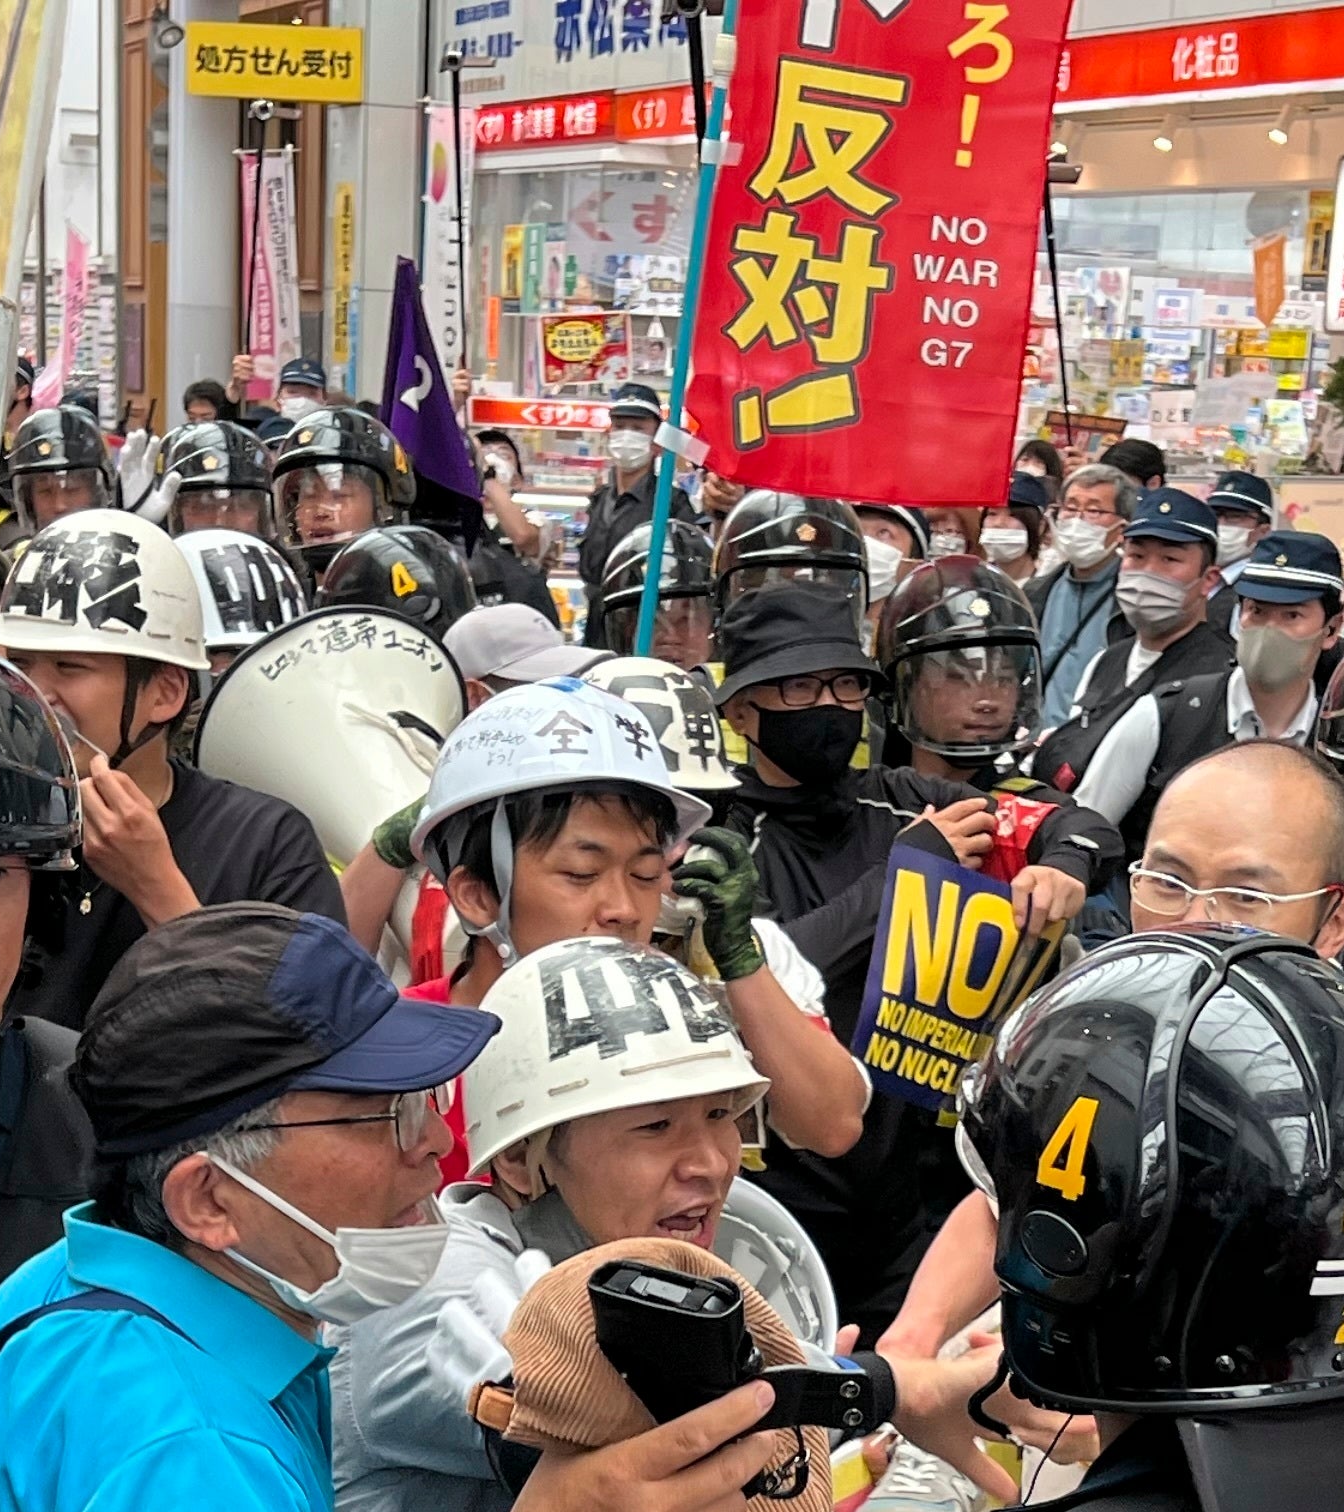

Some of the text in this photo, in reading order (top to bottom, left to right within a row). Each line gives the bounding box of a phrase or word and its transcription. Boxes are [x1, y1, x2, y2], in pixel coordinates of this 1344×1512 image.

[195, 44, 353, 82] 処方せん受付
[1171, 32, 1240, 82] 化粧品
[930, 214, 988, 245] NO
[913, 252, 999, 288] WAR
[922, 298, 980, 328] NO
[920, 337, 974, 369] G7
[391, 562, 418, 597] 4
[882, 869, 1018, 1021] NO
[876, 997, 994, 1062] NO IMPERIAL
[864, 1033, 962, 1095] NO NUCL
[1037, 1097, 1099, 1202] 4
